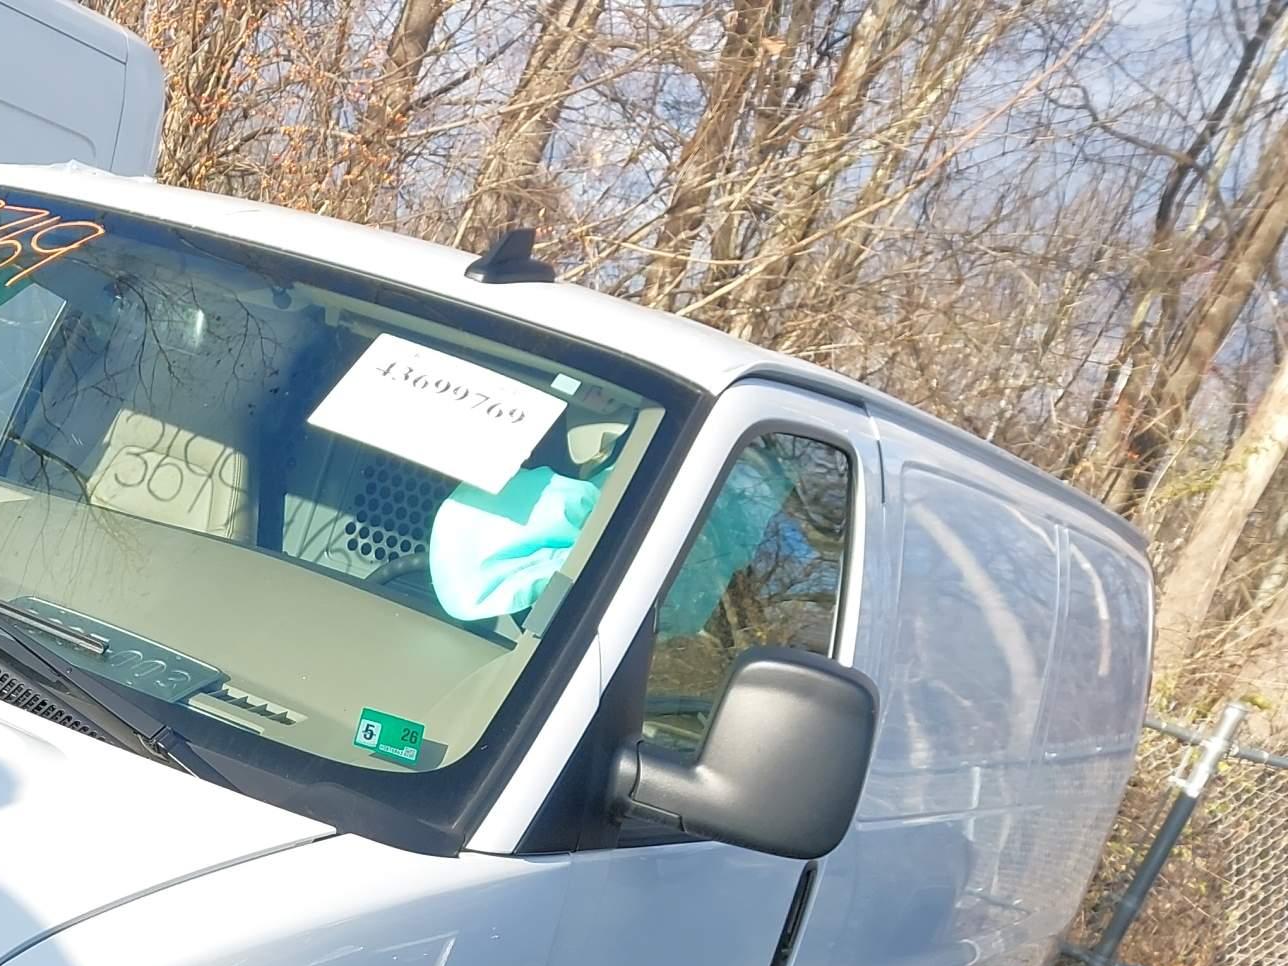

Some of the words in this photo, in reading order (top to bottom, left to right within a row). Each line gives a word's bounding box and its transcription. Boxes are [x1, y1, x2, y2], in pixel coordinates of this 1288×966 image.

[376, 361, 526, 424] 43699769
[362, 722, 376, 741] 5
[400, 727, 419, 745] 26
